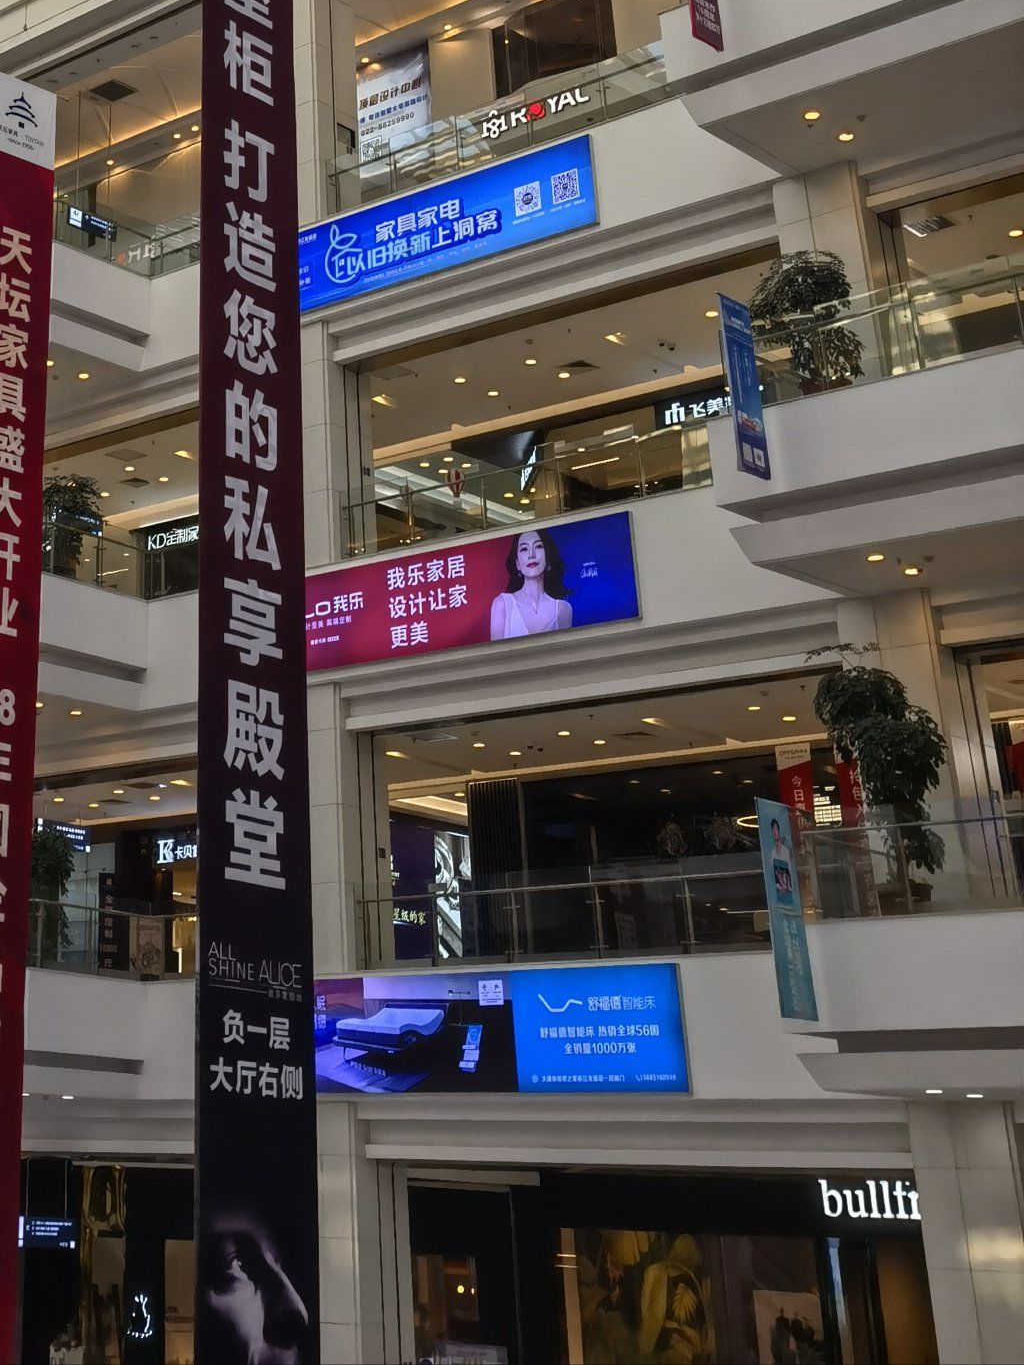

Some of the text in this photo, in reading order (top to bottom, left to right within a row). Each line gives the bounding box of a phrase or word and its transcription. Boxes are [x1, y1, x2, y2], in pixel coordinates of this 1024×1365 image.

[375, 198, 461, 244] 家具家电
[223, 119, 286, 890] 打造您的私享殿堂
[386, 554, 466, 591] 我乐家居
[333, 591, 364, 614] 我乐
[388, 584, 468, 619] 设计让家
[390, 621, 429, 649] 更美
[208, 941, 236, 961] ALL
[208, 957, 255, 982] SHINE
[587, 994, 657, 1012] 舒福德智能床
[222, 1009, 291, 1052] 负一层
[540, 1024, 660, 1039] 舒福德智能床 热销全球56国
[564, 1042, 637, 1055] 全销量1000万张
[209, 1056, 304, 1100] 大厅右侧
